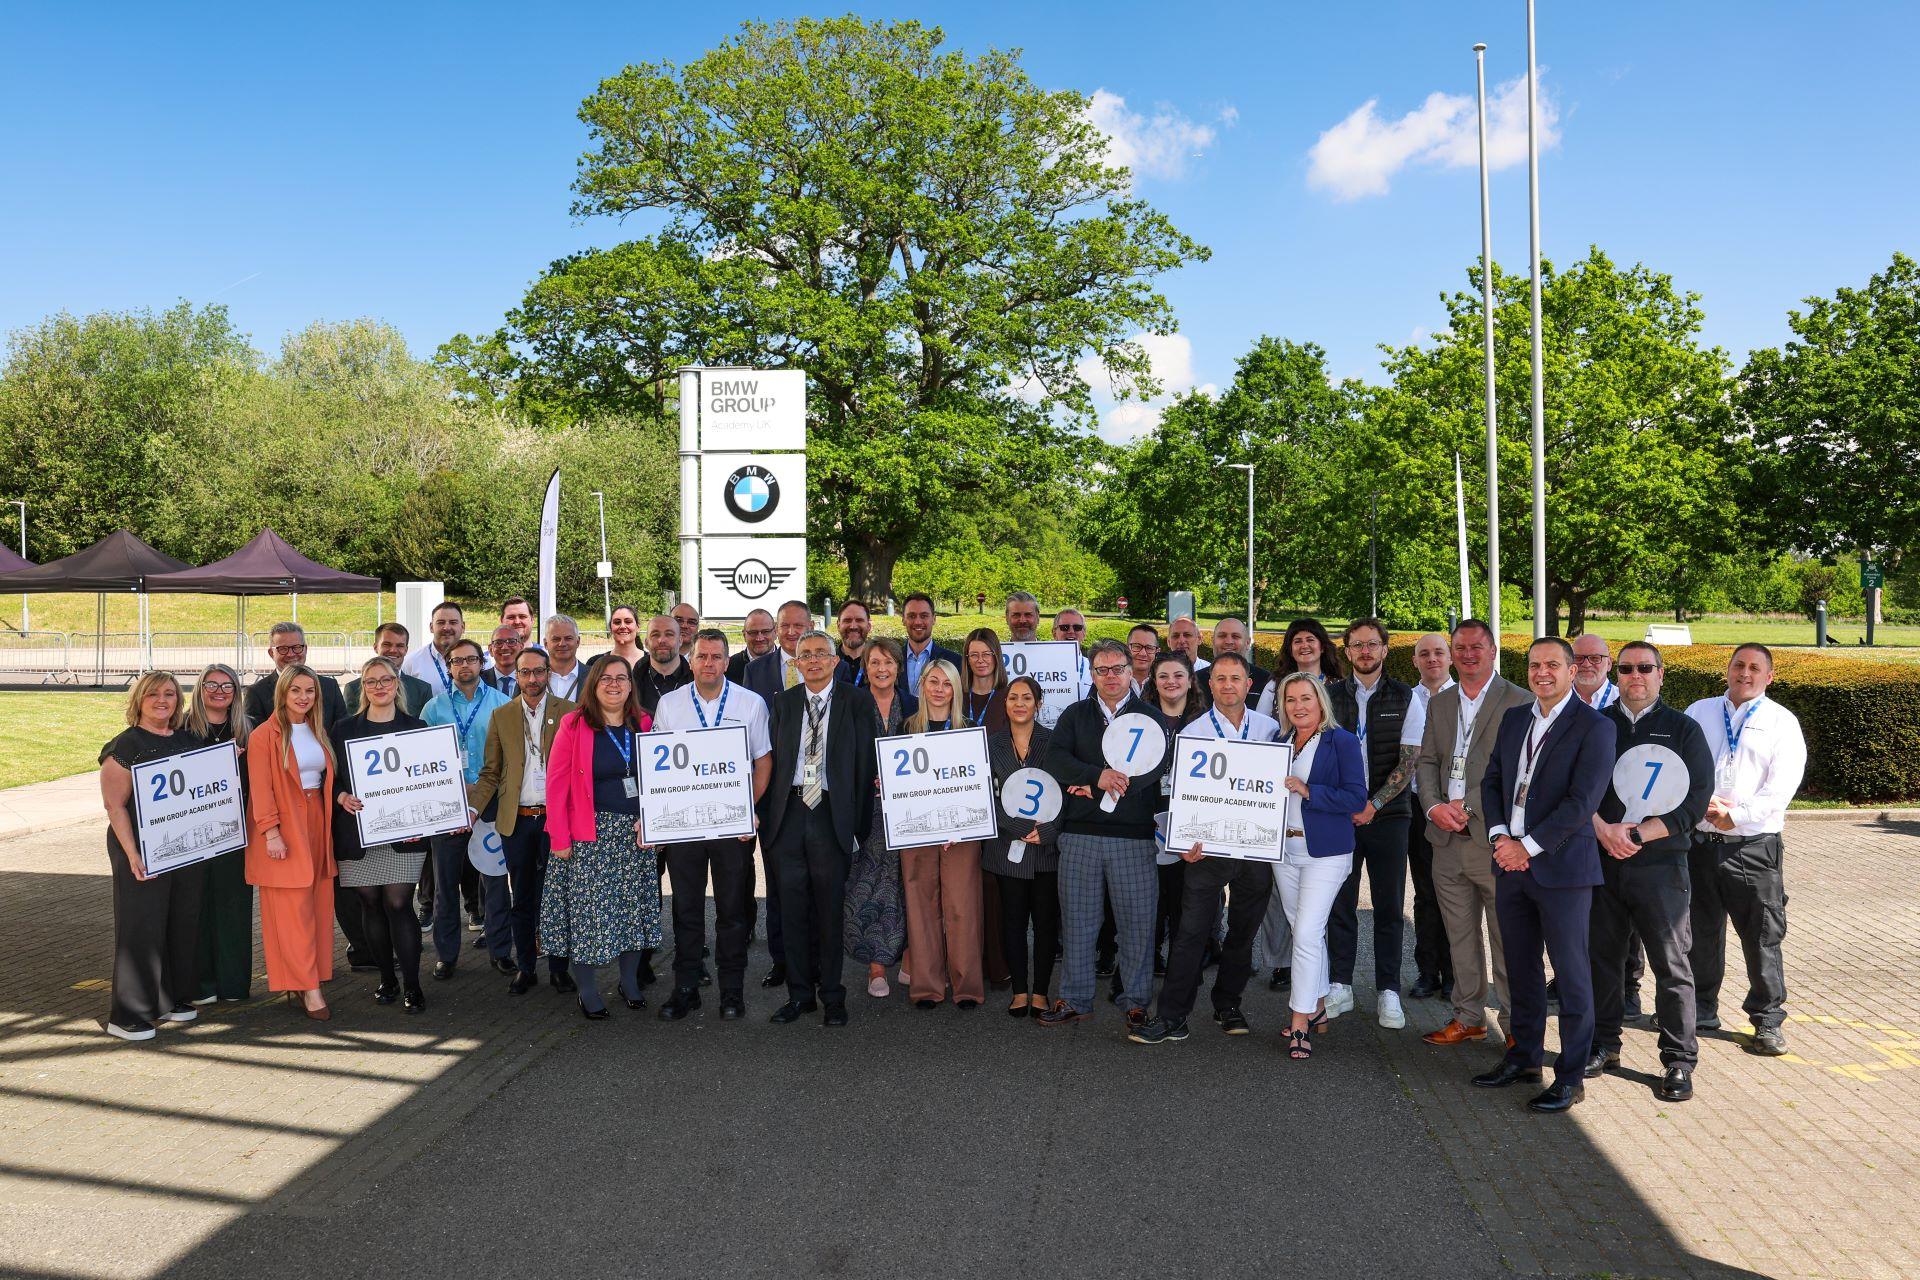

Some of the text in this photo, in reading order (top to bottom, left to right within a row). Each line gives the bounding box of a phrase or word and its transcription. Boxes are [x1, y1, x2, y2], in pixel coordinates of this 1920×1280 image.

[711, 380, 759, 396] BMW
[711, 397, 776, 413] GROUP
[729, 466, 776, 486] BMW
[738, 574, 767, 585] MINI
[1030, 671, 1067, 682] YEARS
[1127, 728, 1145, 763] 7
[364, 746, 448, 778] 20 YEARS
[653, 743, 736, 777] 20 YEARS
[893, 747, 976, 781] 20 YEARS
[1189, 750, 1274, 794] 20 YEARS
[151, 769, 228, 802] 20 YEARS
[364, 778, 453, 799] BMW GROUP ACADEMY UK/IE
[650, 780, 741, 795] BMW GROUP ACADEMY UK/IE
[892, 783, 981, 800] BMW GROUP ACADEMY UK/IE
[1641, 761, 1664, 801] 7
[1018, 780, 1044, 816] 3
[1181, 793, 1276, 810] BMW GROUP ACADEMY UK/IE
[150, 797, 233, 826] BMW GROUP ACADEMY UK/IE
